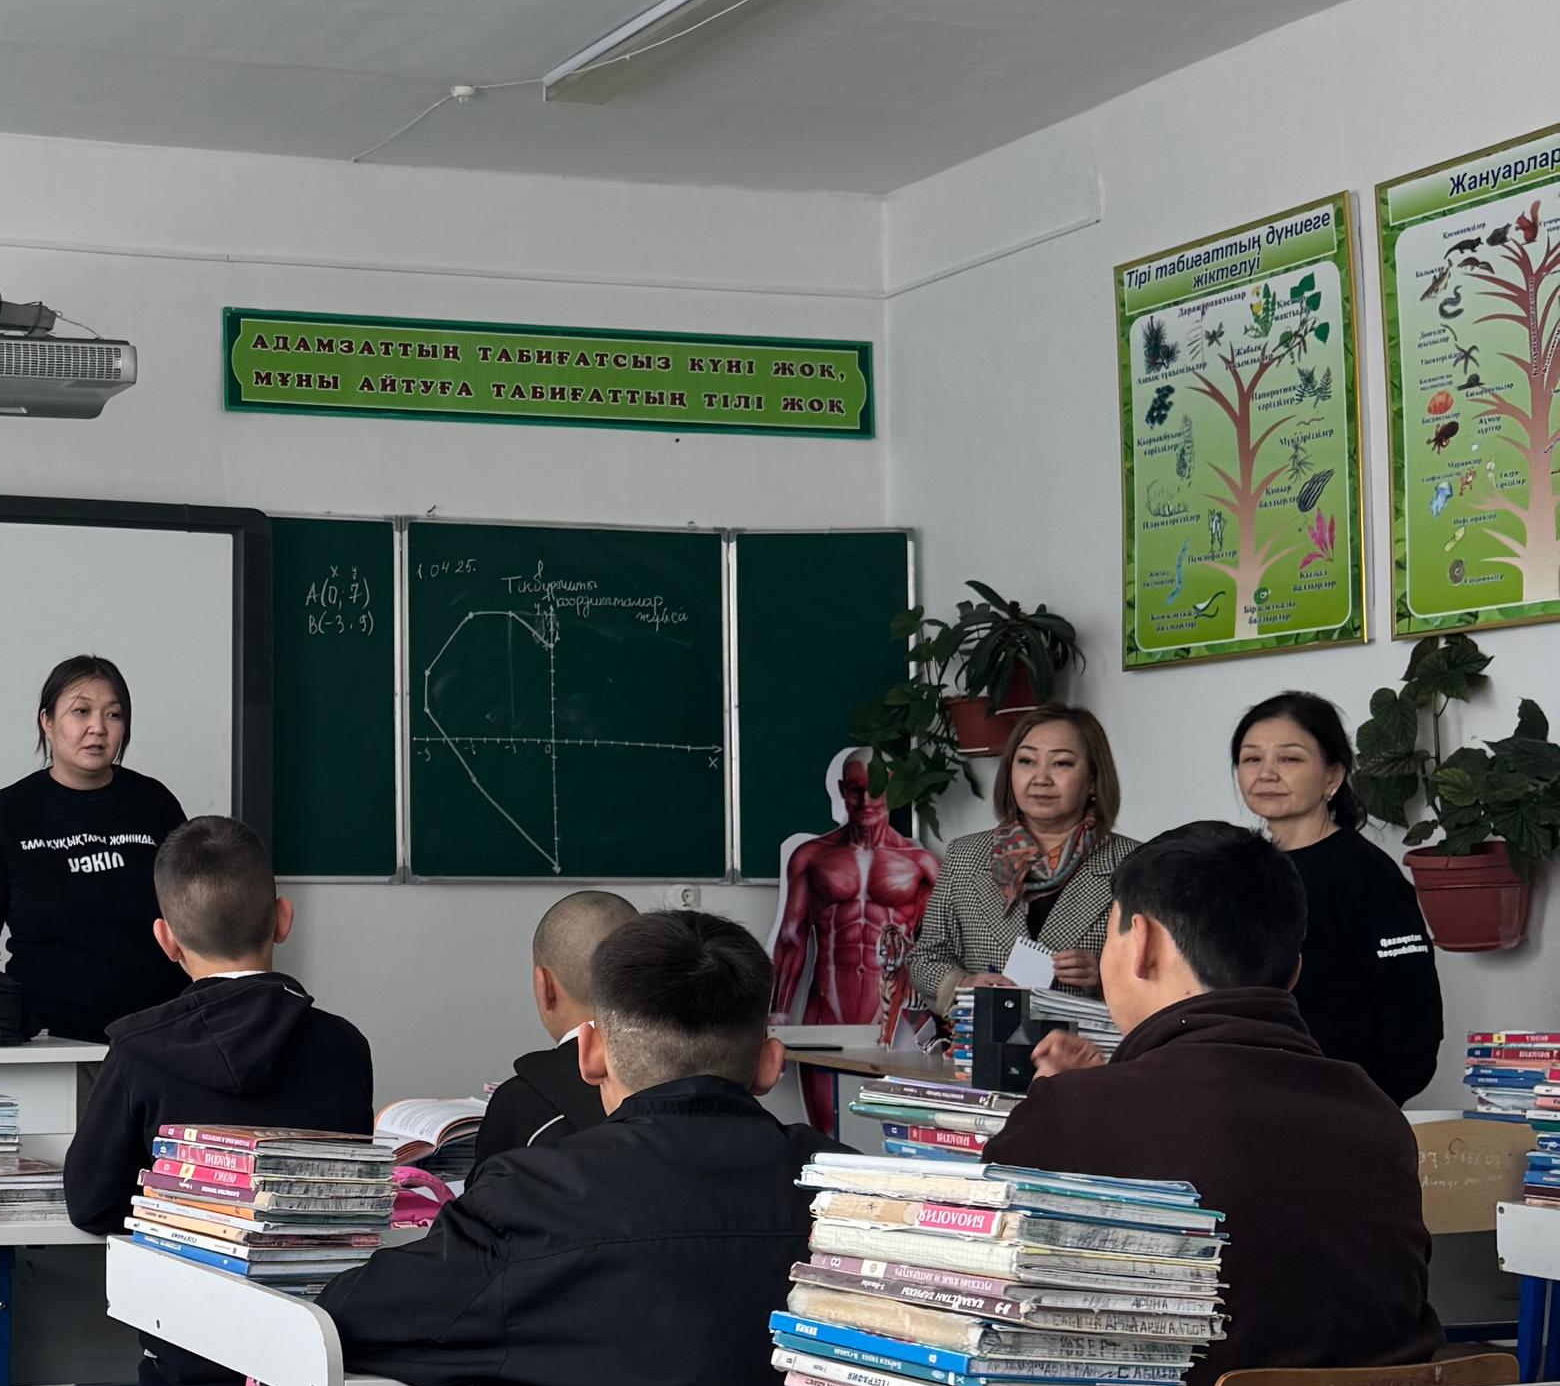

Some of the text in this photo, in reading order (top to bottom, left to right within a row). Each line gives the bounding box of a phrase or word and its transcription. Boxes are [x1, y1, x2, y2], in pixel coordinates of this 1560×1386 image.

[1126, 212, 1331, 290] Тірі табиғаттың дүниеге
[1192, 252, 1261, 290] жіктелуі
[251, 333, 847, 382] АДАМЗАТТЫҢ ТАБИҒАТСЫЗ КҮНІ ЖОҚ,
[253, 370, 847, 415] МҰНЫ АЙТУҒА ТАБИҒАТТЫҢ ТІЛІ ЖОҚ
[20, 839, 46, 850] БАЛА
[918, 1208, 985, 1228] БИОЛОГИЯ
